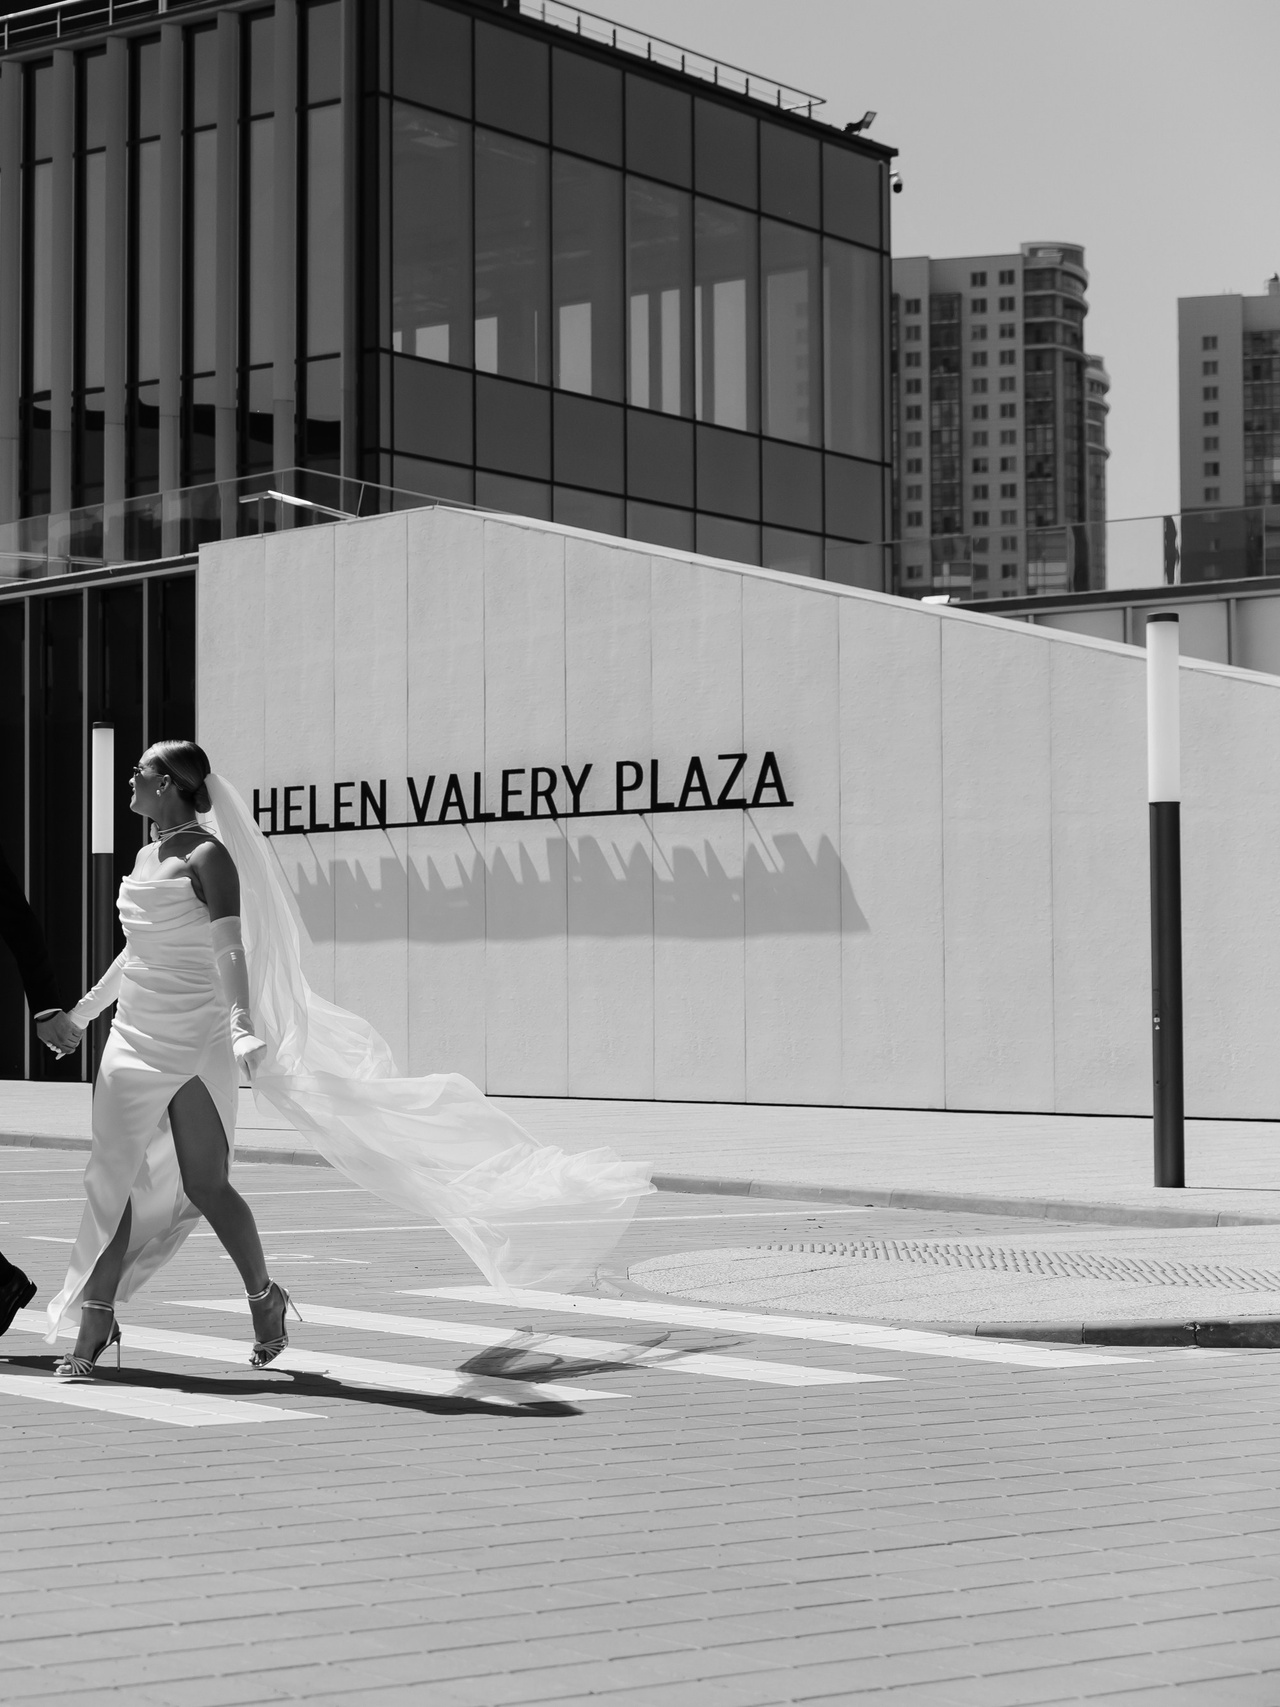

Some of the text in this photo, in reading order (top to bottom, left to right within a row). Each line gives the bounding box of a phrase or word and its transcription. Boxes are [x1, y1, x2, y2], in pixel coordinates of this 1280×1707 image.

[253, 751, 788, 834] HELEN VALERY PLAZA
